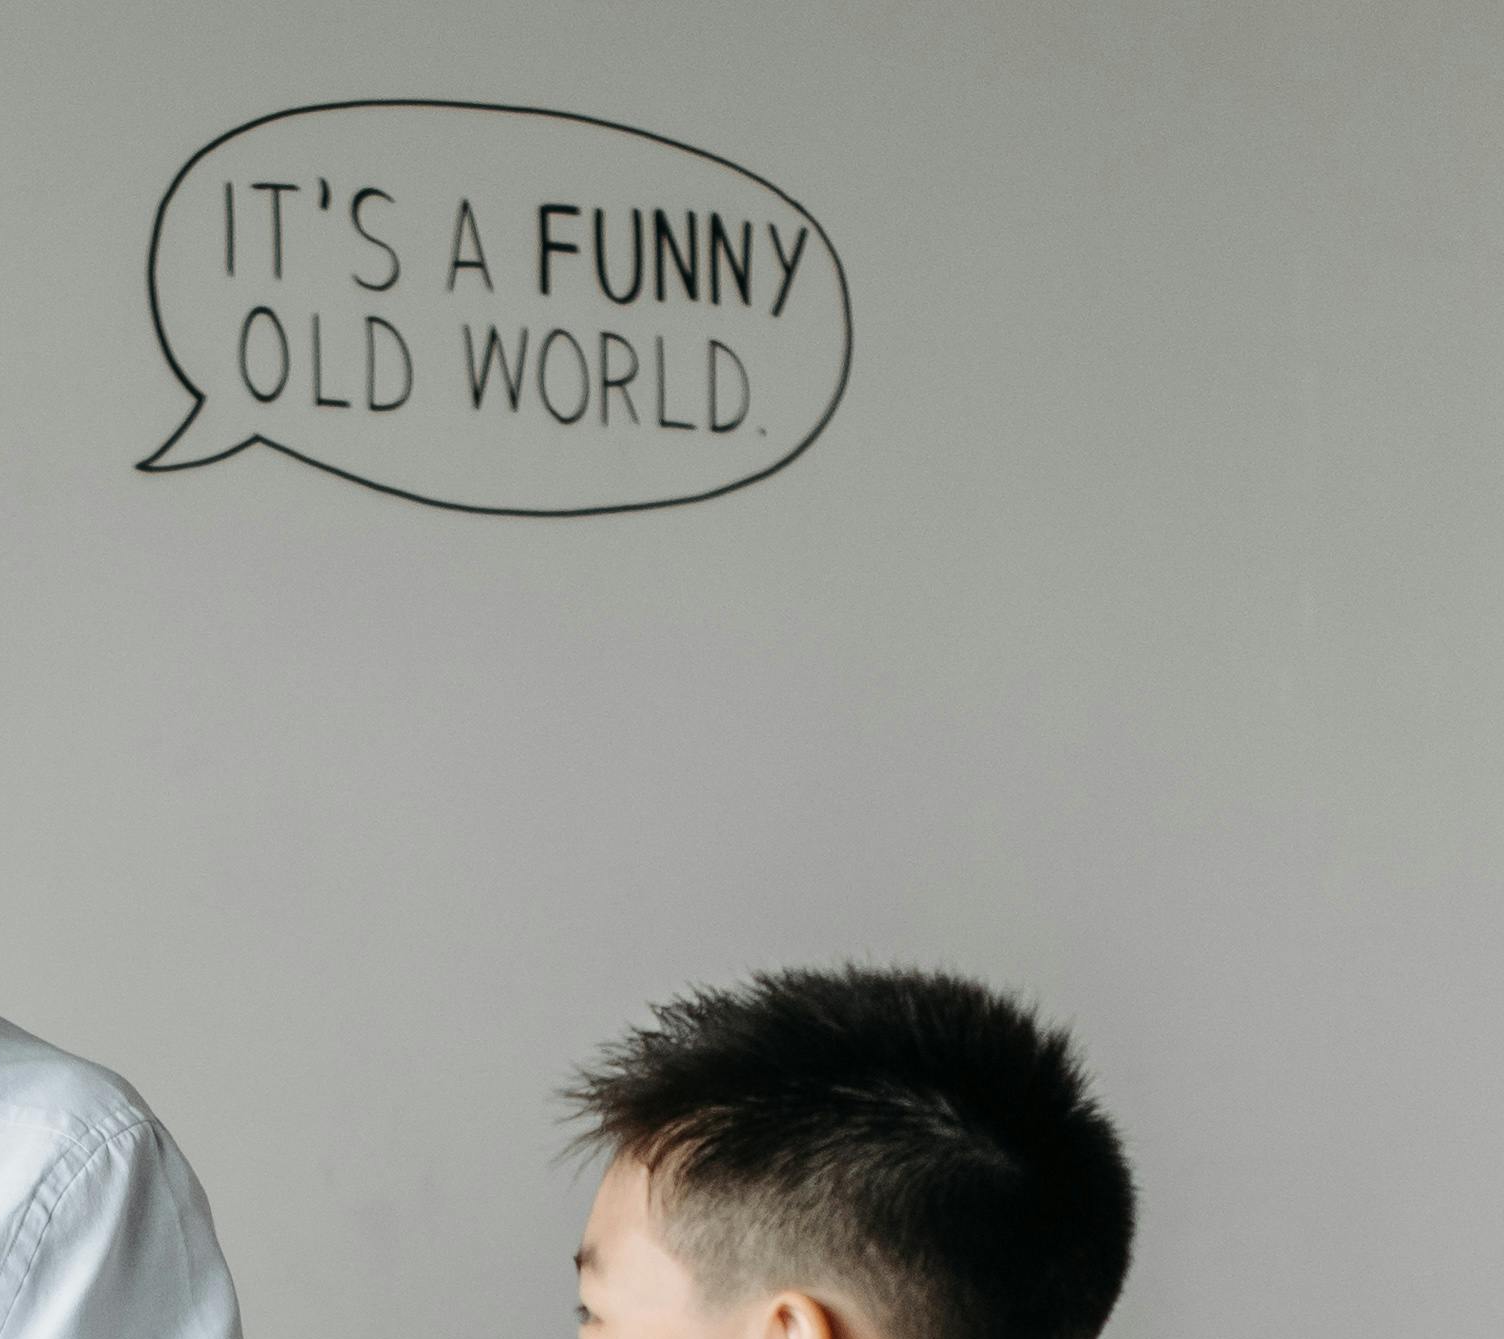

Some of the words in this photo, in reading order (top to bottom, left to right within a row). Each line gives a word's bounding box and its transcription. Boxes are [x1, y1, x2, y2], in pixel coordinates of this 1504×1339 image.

[224, 177, 402, 291] IT'S
[448, 199, 495, 293] A
[537, 204, 810, 318] FUNNY
[238, 305, 414, 413] OLD
[463, 324, 768, 438] WORLD.
